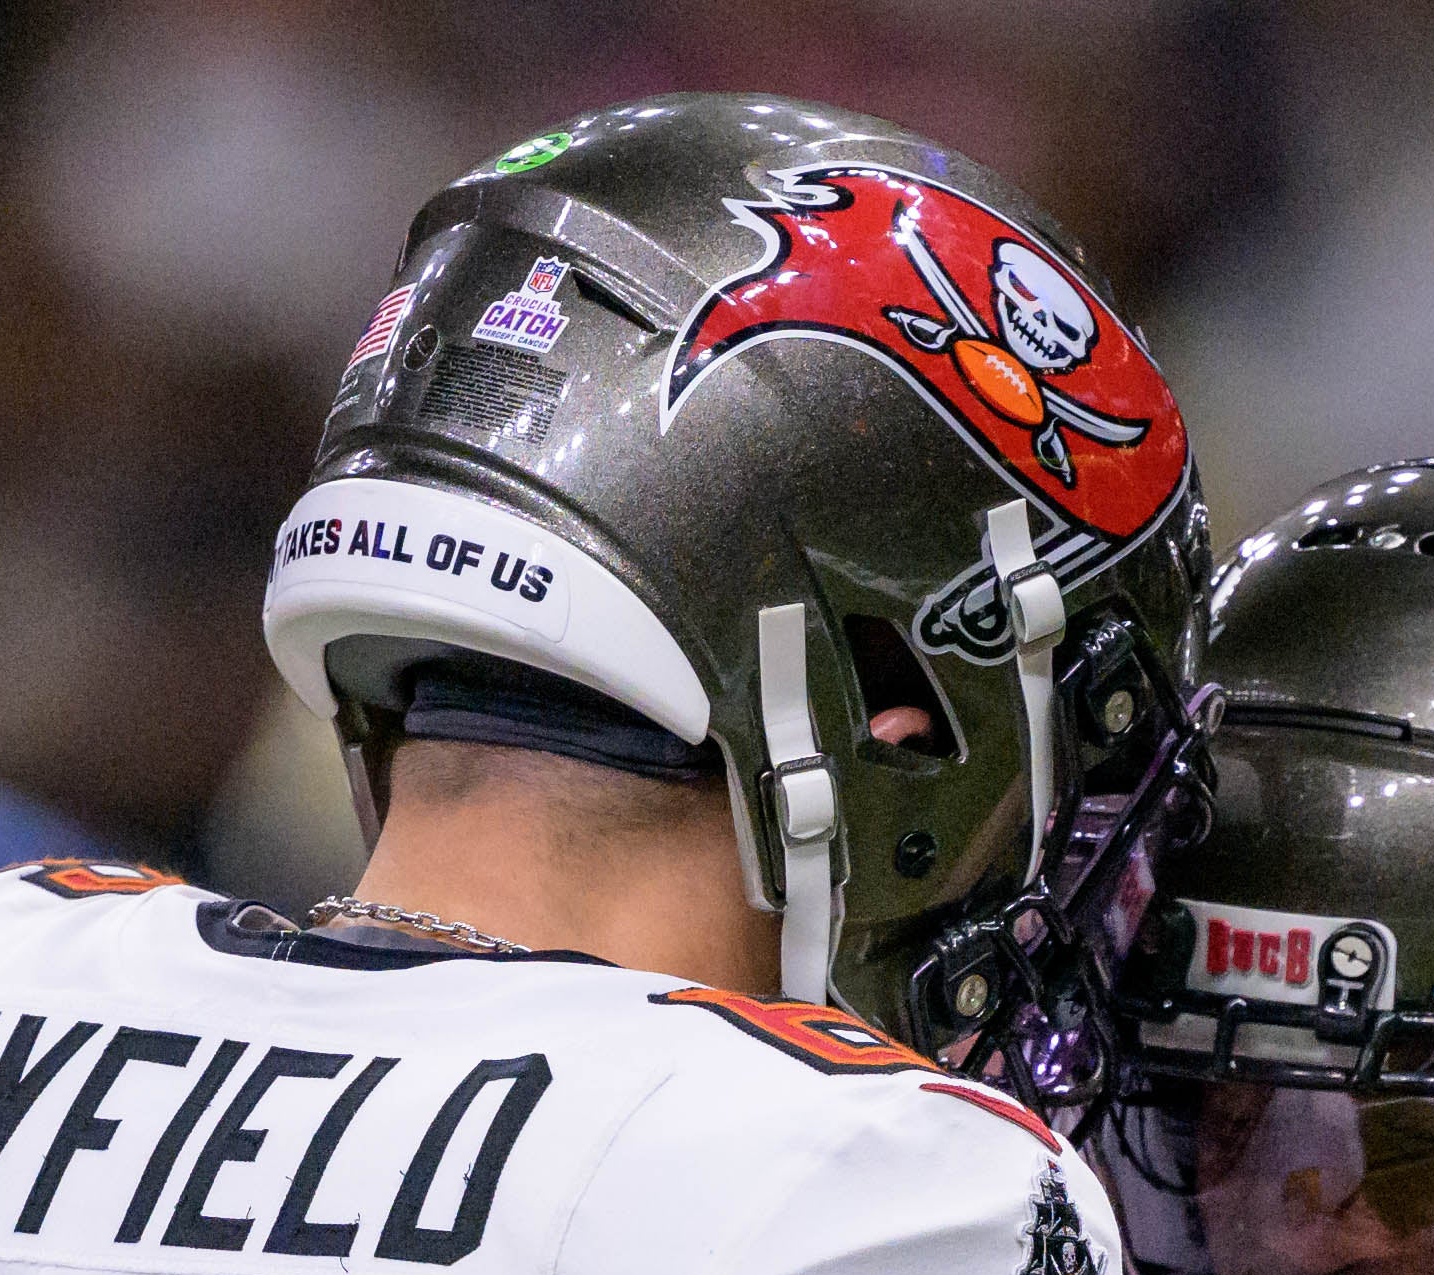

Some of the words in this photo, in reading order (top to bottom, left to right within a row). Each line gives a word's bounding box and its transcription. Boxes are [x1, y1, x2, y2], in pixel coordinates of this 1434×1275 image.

[529, 272, 554, 290] NFL
[504, 294, 557, 315] CRUCIAL
[483, 304, 564, 340] CATCH
[475, 327, 515, 341] INTERCEPT
[517, 336, 550, 350] CANCER
[282, 519, 343, 569] TAKES
[347, 519, 413, 564] ALL
[425, 533, 485, 576] OF
[490, 551, 554, 603] US
